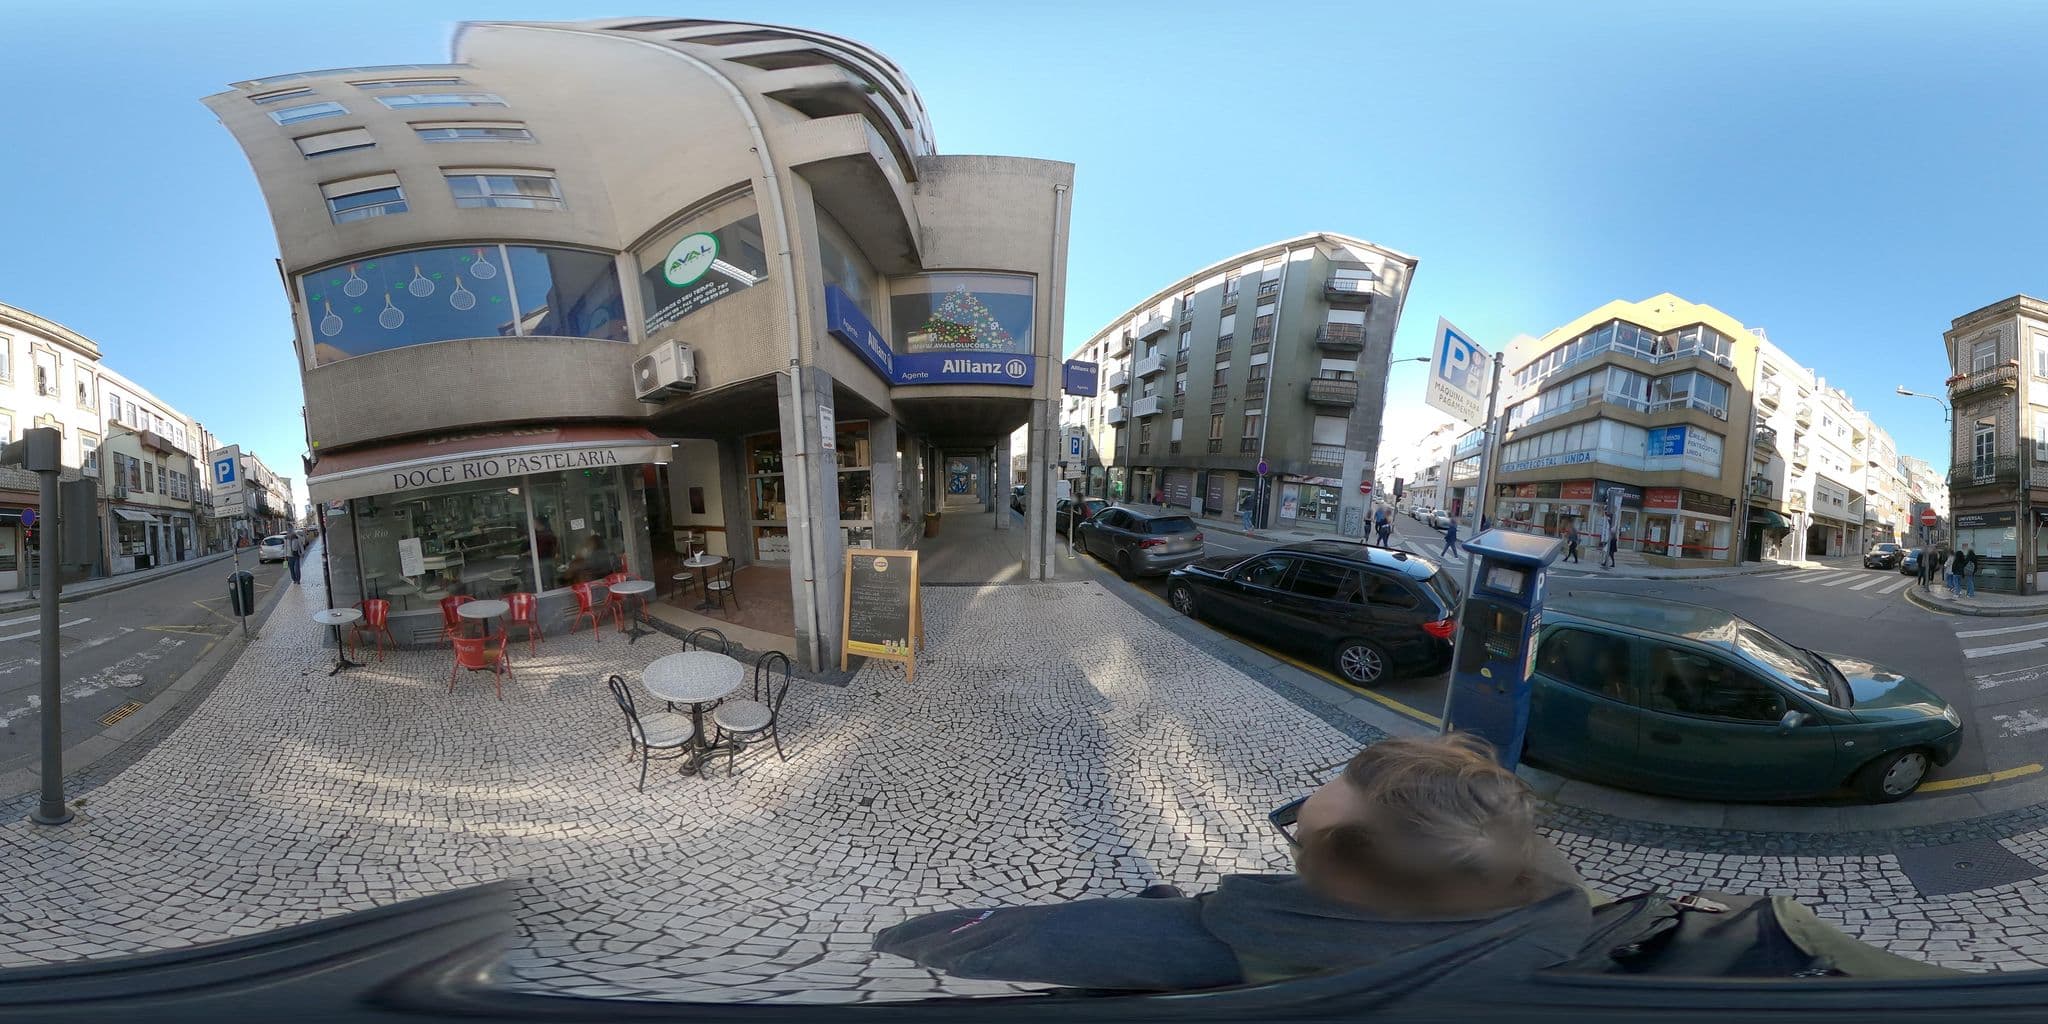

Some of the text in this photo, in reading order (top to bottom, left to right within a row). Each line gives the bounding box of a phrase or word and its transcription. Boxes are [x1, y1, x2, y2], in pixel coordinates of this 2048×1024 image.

[669, 245, 712, 274] AVAL
[868, 330, 888, 365] Allianz
[1444, 335, 1471, 379] P
[902, 371, 929, 380] Agente
[942, 359, 1002, 374] Allianz
[1439, 394, 1474, 418] PAGAMENTO
[393, 450, 618, 490] DOCE RIO PASTELARIA
[1564, 453, 1591, 464] UNIDA
[218, 462, 230, 482] P
[375, 528, 389, 538] Rio
[1537, 572, 1545, 600] P
